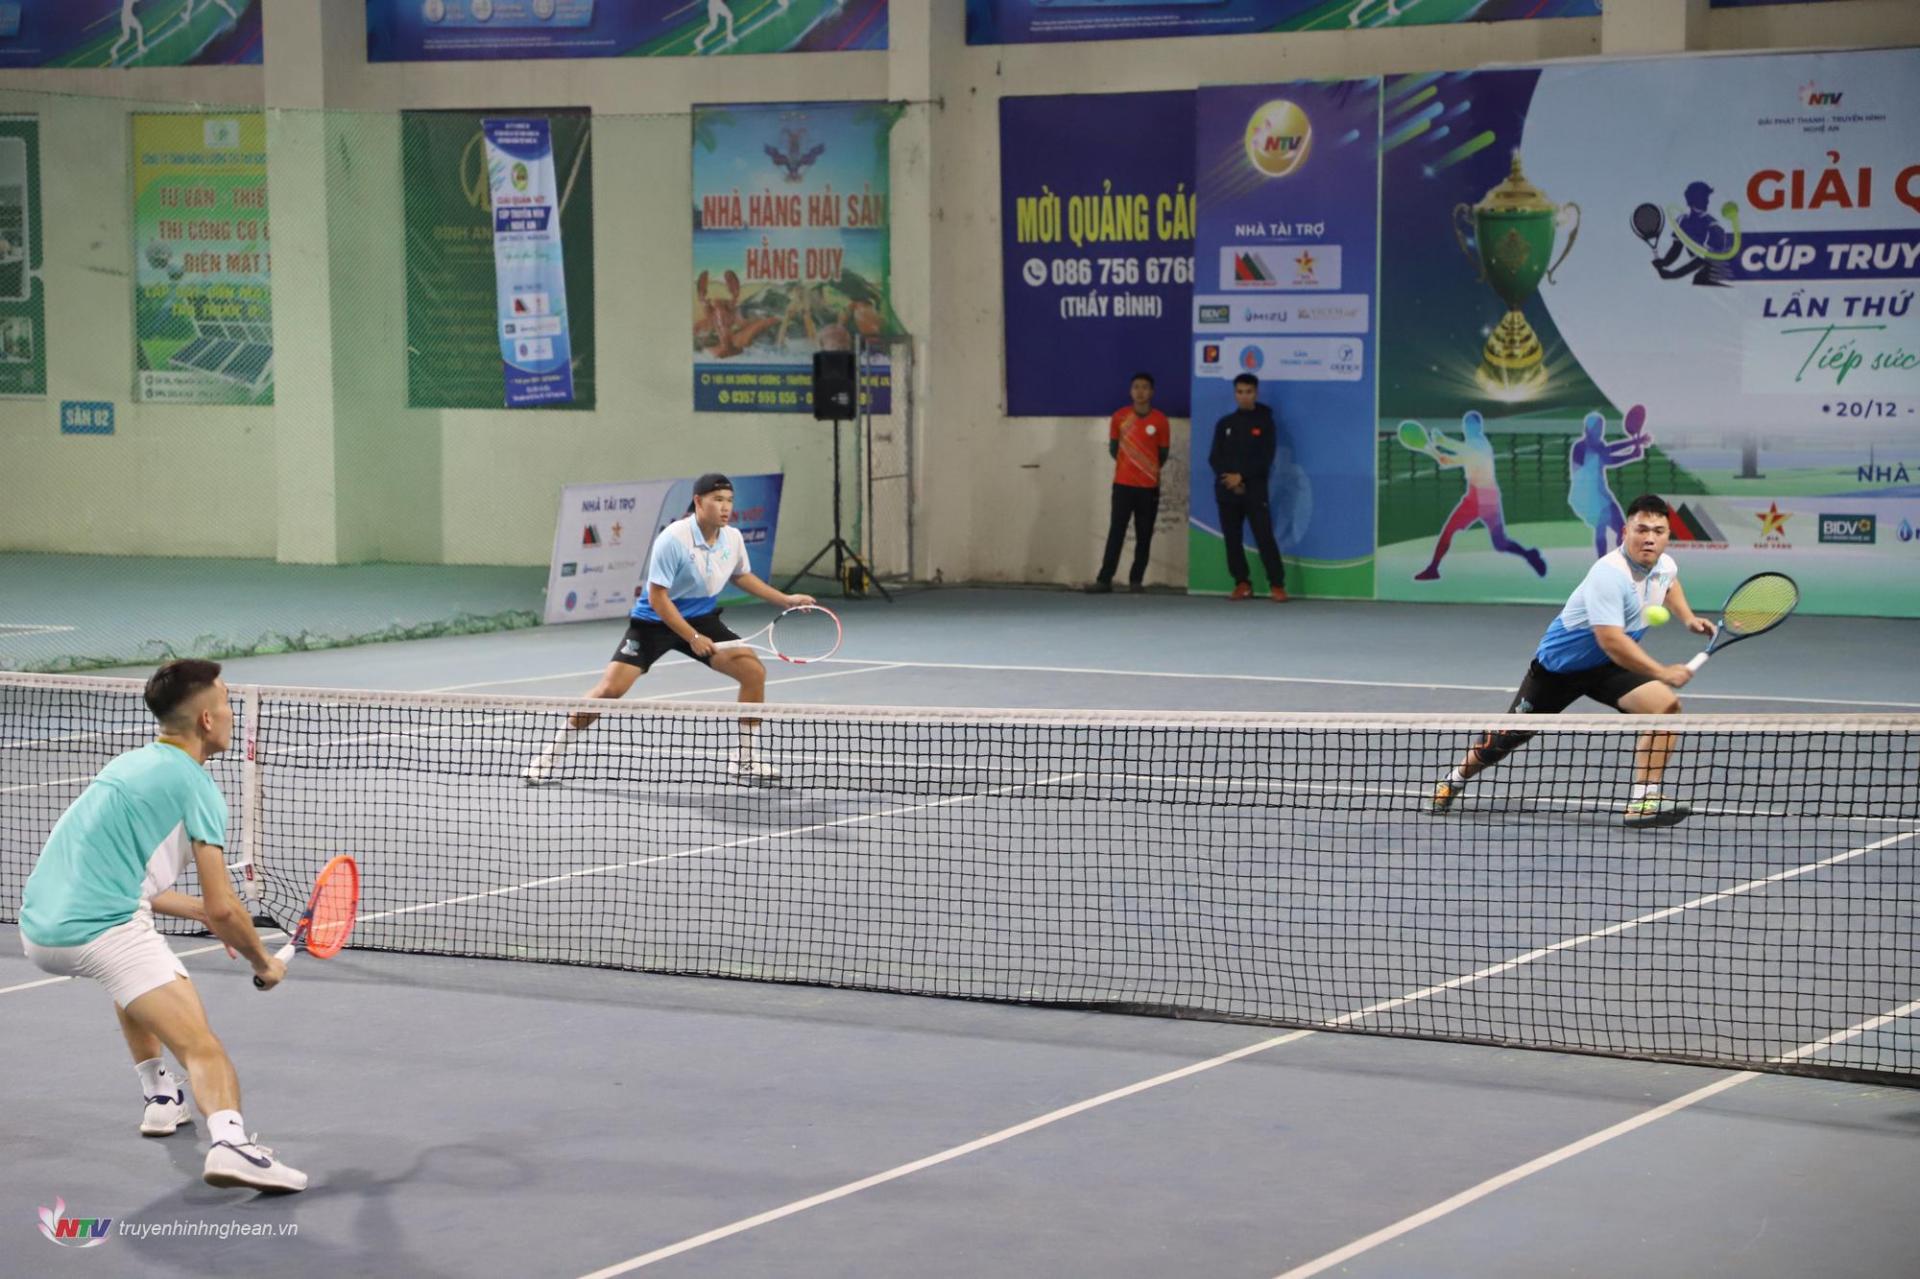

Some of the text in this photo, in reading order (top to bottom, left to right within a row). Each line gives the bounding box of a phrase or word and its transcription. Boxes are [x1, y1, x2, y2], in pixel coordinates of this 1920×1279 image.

[1809, 92, 1843, 105] NTV
[1264, 136, 1301, 151] NTV
[1746, 150, 1872, 211] GIẢI
[703, 187, 743, 228] NHÀ
[748, 186, 802, 227] HÀNG
[808, 184, 841, 226] HẢI
[1016, 184, 1062, 243] MỜI
[1068, 179, 1149, 248] QUẢNG
[1235, 220, 1325, 237] NHÀ TÀI TRỢ
[805, 247, 845, 280] DUY
[1741, 238, 1920, 271] CÚP TRUY
[1051, 258, 1091, 285] 086
[1097, 258, 1139, 285] 756
[1113, 291, 1162, 319] BÌNH)
[1763, 289, 1914, 318] LẦN THỨ
[1781, 323, 1887, 385] Tiếp
[65, 404, 110, 427] SÂN 02
[1836, 400, 1897, 418] 20/12
[1858, 462, 1910, 483] NHÀ
[582, 496, 600, 512] NHÀ
[619, 497, 636, 513] TRỢ
[1824, 521, 1857, 535] BIDV
